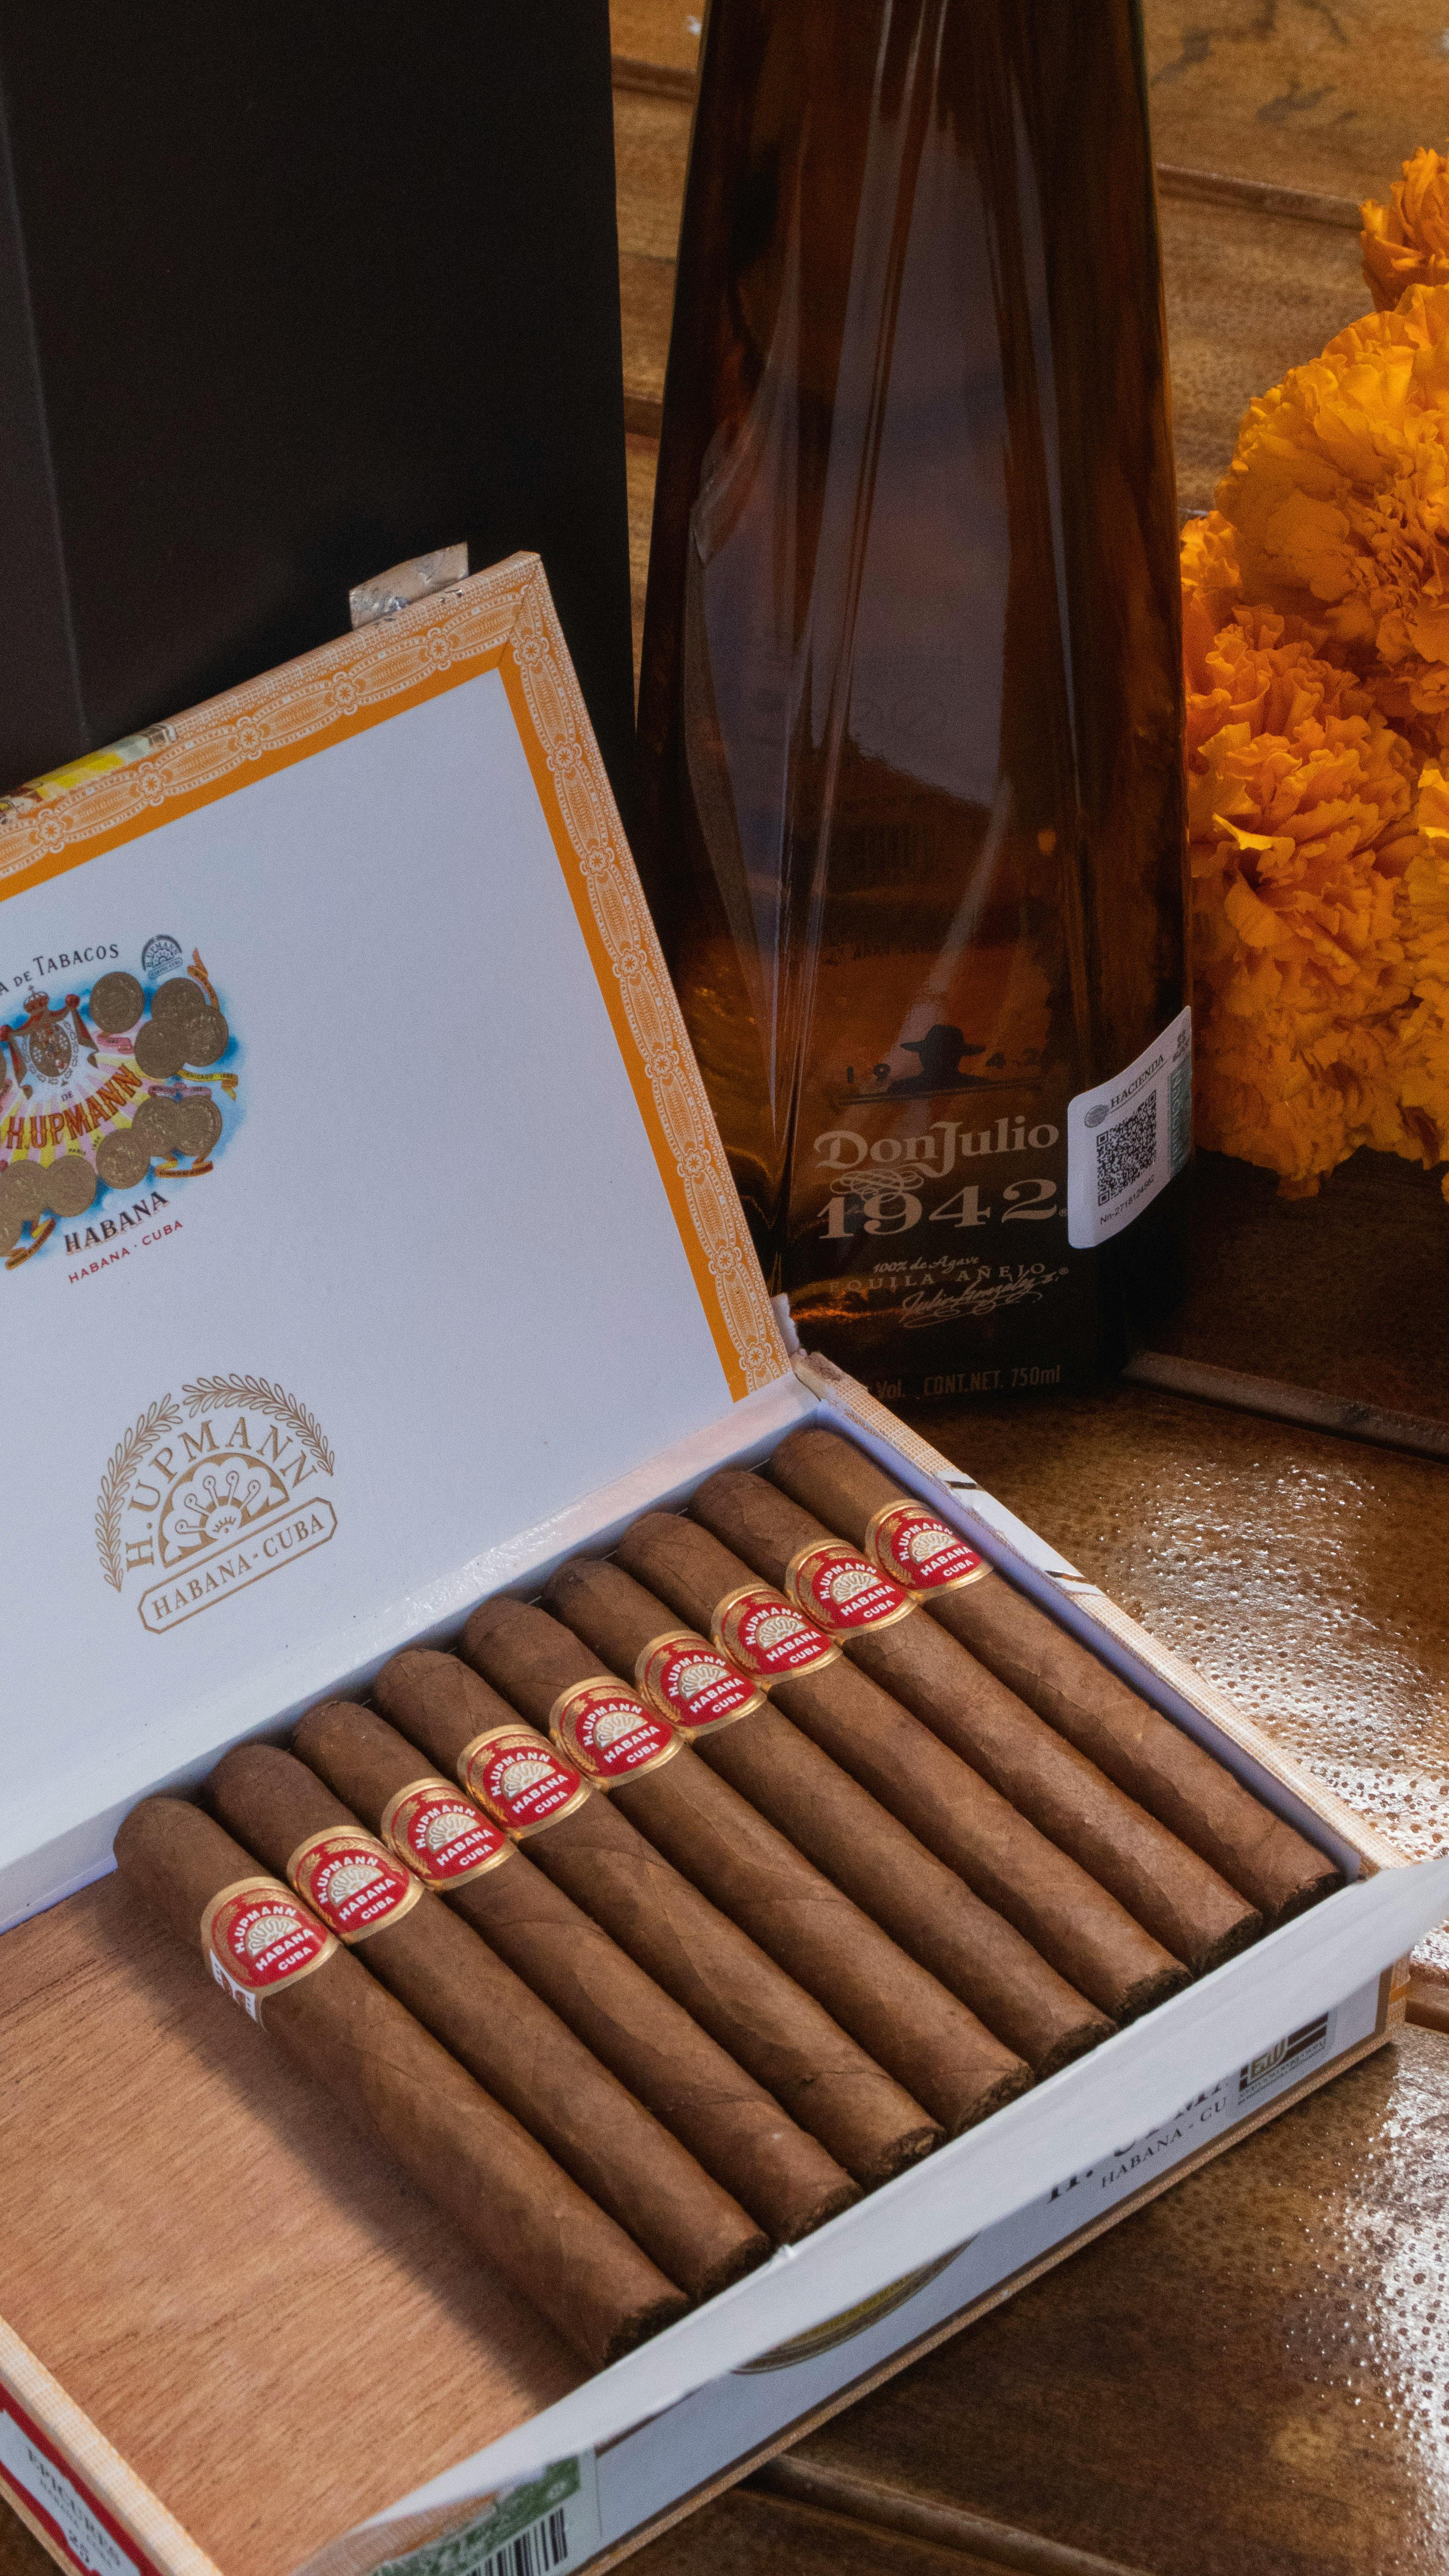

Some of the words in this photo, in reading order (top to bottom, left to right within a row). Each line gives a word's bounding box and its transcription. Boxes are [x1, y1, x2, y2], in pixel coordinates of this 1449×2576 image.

[14, 971, 33, 987] DE
[33, 944, 119, 976] TABACOS
[61, 1091, 73, 1102] DE
[1110, 1054, 1165, 1108] HACIENDA
[6, 1062, 143, 1150] H.UPMANN
[64, 1191, 170, 1256] HABANA
[816, 1178, 1058, 1239] 1942
[68, 1247, 131, 1284] HABANA
[142, 1219, 184, 1246] CUBA
[1011, 1364, 1061, 1388] 750ml
[920, 1546, 973, 1577] HABANA
[943, 1559, 974, 1578] CUBA
[840, 1584, 895, 1617] HABANA
[863, 1598, 896, 1619] CUBA
[766, 1630, 821, 1663] HABANA
[789, 1644, 822, 1665] CUBA
[689, 1677, 745, 1714] HABANA
[711, 1692, 745, 1713] CUBA
[603, 1725, 661, 1764] HABANA
[626, 1741, 660, 1764] CUBA
[512, 1774, 569, 1815] HABANA
[534, 1790, 568, 1814] CUBA
[436, 1829, 494, 1867] HABANA
[459, 1843, 494, 1867] CUBA
[339, 1877, 397, 1921] HABANA
[360, 1896, 396, 1920] CUBA
[255, 1928, 315, 1972] HABANA
[277, 1946, 314, 1971] CUBA
[1101, 2127, 1183, 2189] HABANA
